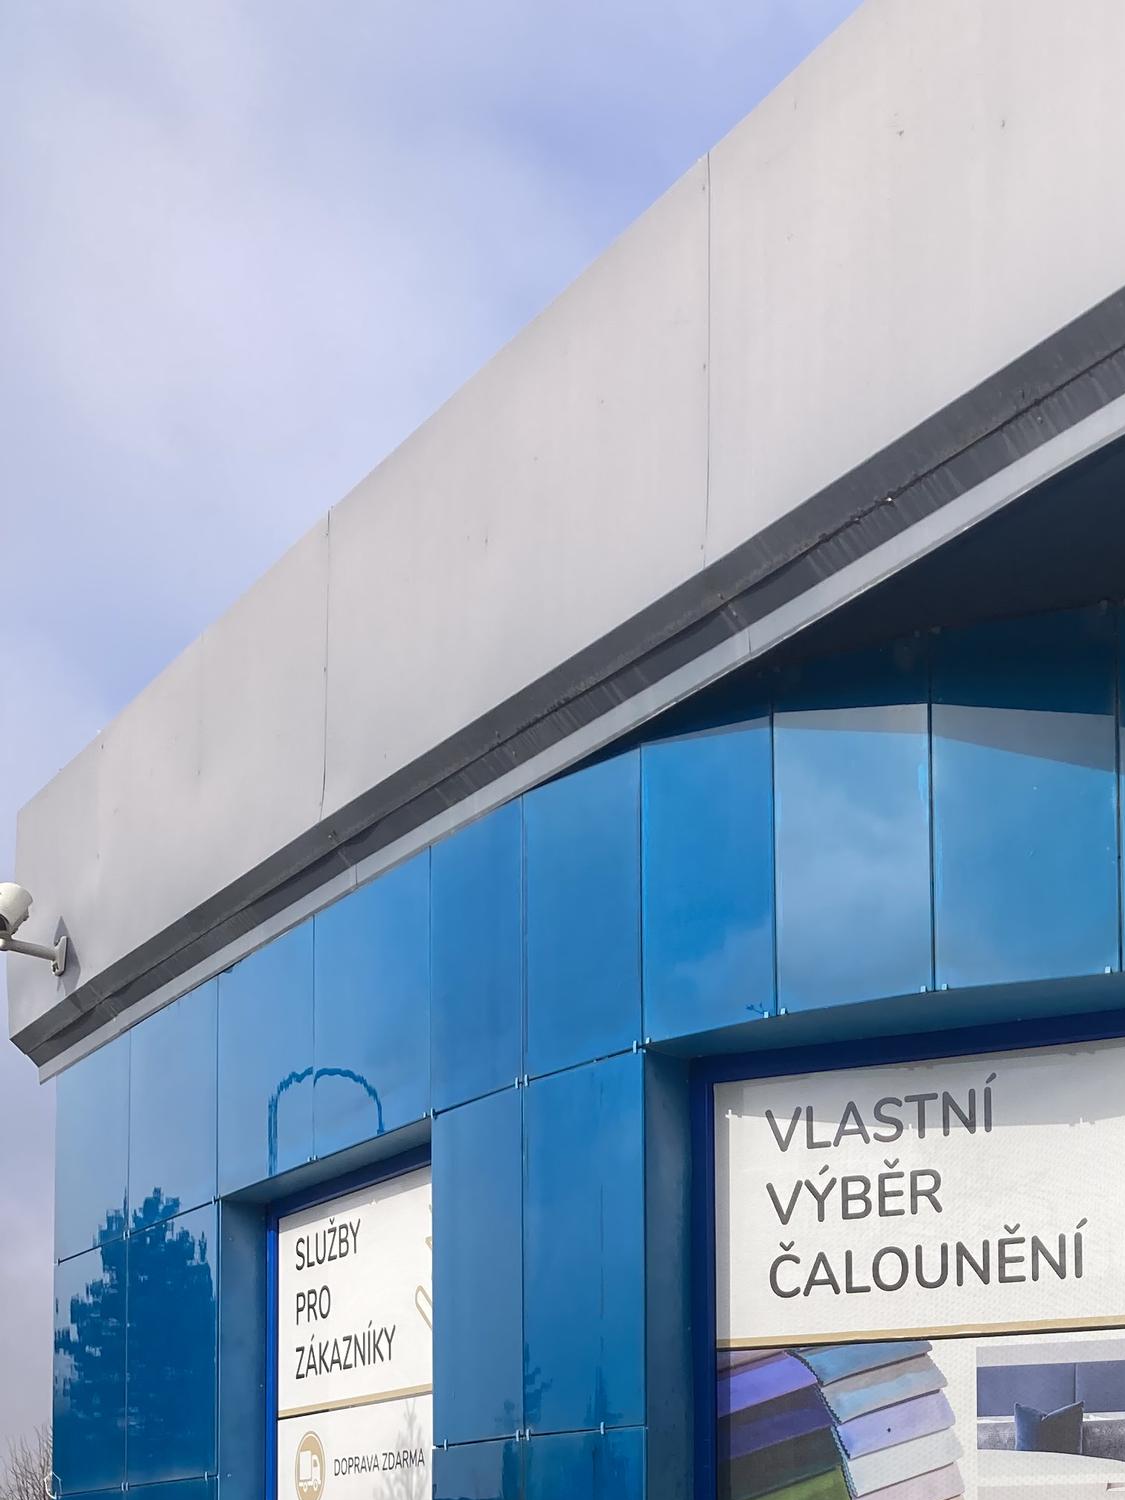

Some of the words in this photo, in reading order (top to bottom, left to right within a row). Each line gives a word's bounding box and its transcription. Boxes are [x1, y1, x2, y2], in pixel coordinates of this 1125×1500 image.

[765, 1072, 997, 1153] VLASTNÍ
[766, 1158, 943, 1226] VÝBĚR
[295, 1217, 361, 1271] SLUŽBY
[768, 1217, 1089, 1299] ČALOUNĚNÍ
[296, 1285, 331, 1326] PRO
[295, 1320, 396, 1380] ZÁKAZNÍKY
[333, 1455, 379, 1477] DOPRAVA
[382, 1448, 426, 1471] ZDARMA
